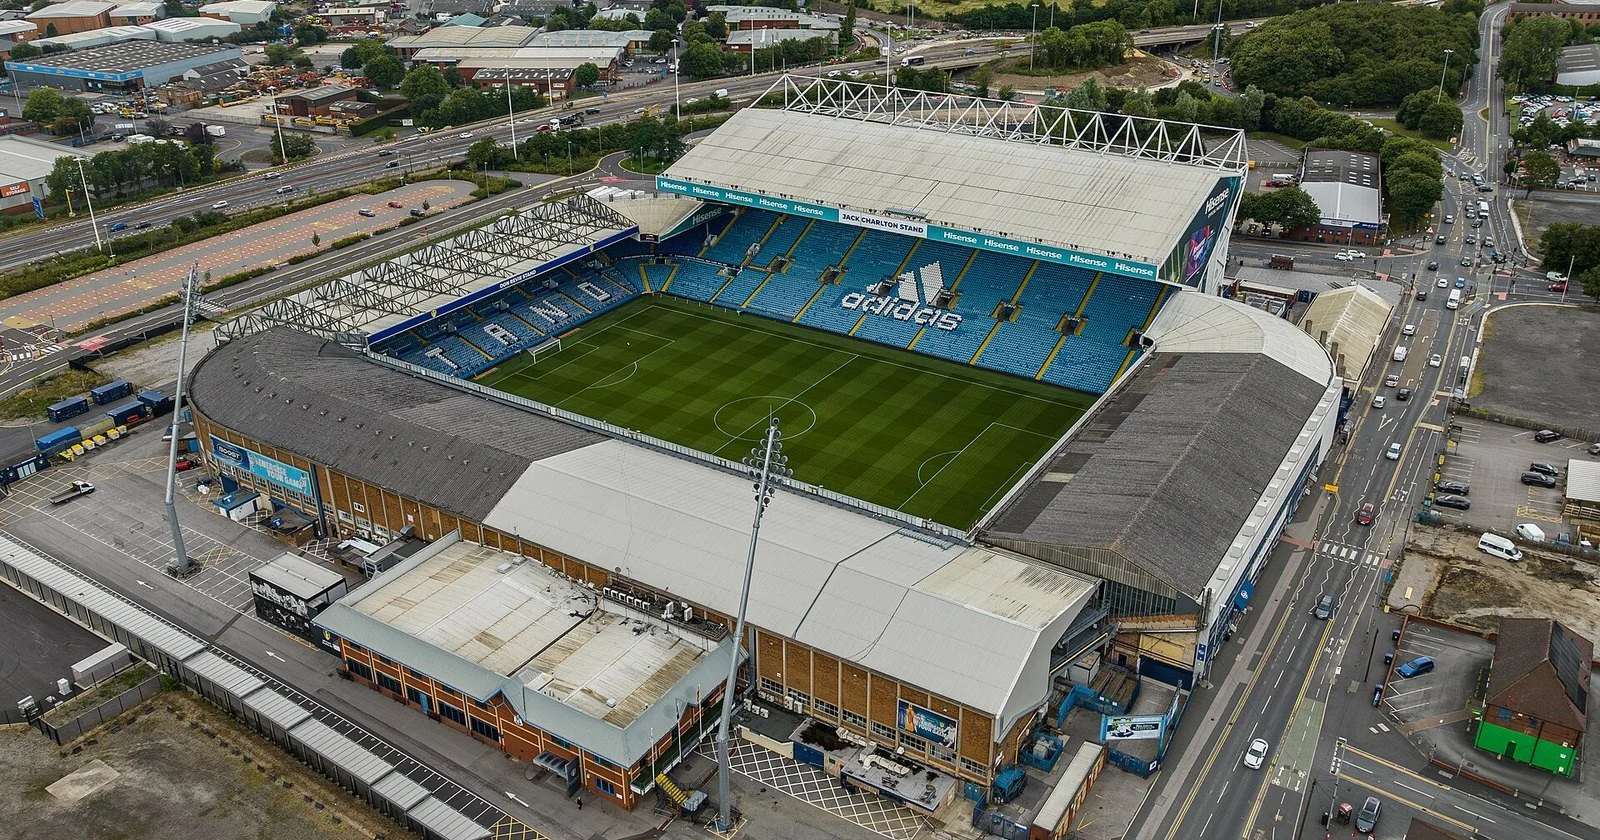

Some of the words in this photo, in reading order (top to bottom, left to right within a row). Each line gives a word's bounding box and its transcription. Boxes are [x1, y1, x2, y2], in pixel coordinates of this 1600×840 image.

[6, 188, 26, 196] STORAGE
[660, 181, 687, 192] Hisense
[692, 186, 720, 198] Hisense
[725, 192, 753, 204] Hisense
[759, 198, 788, 210] Hisense
[1204, 188, 1230, 214] Hisense
[692, 207, 722, 225] Hisense
[794, 204, 824, 216] Hisense
[842, 214, 860, 222] JACK
[861, 217, 898, 229] CHARLTON
[900, 224, 924, 234] STAND
[943, 231, 978, 244] Hisense
[984, 238, 1020, 252] Hisense
[1026, 246, 1062, 260] Hisense
[1069, 254, 1108, 268] Hisense
[1115, 262, 1154, 277] Hisense
[500, 280, 510, 288] DON
[510, 275, 522, 284] REVIE
[522, 270, 537, 280] STAND
[841, 292, 963, 332] adidas
[218, 446, 240, 460] BOOST
[266, 468, 285, 482] YOUR
